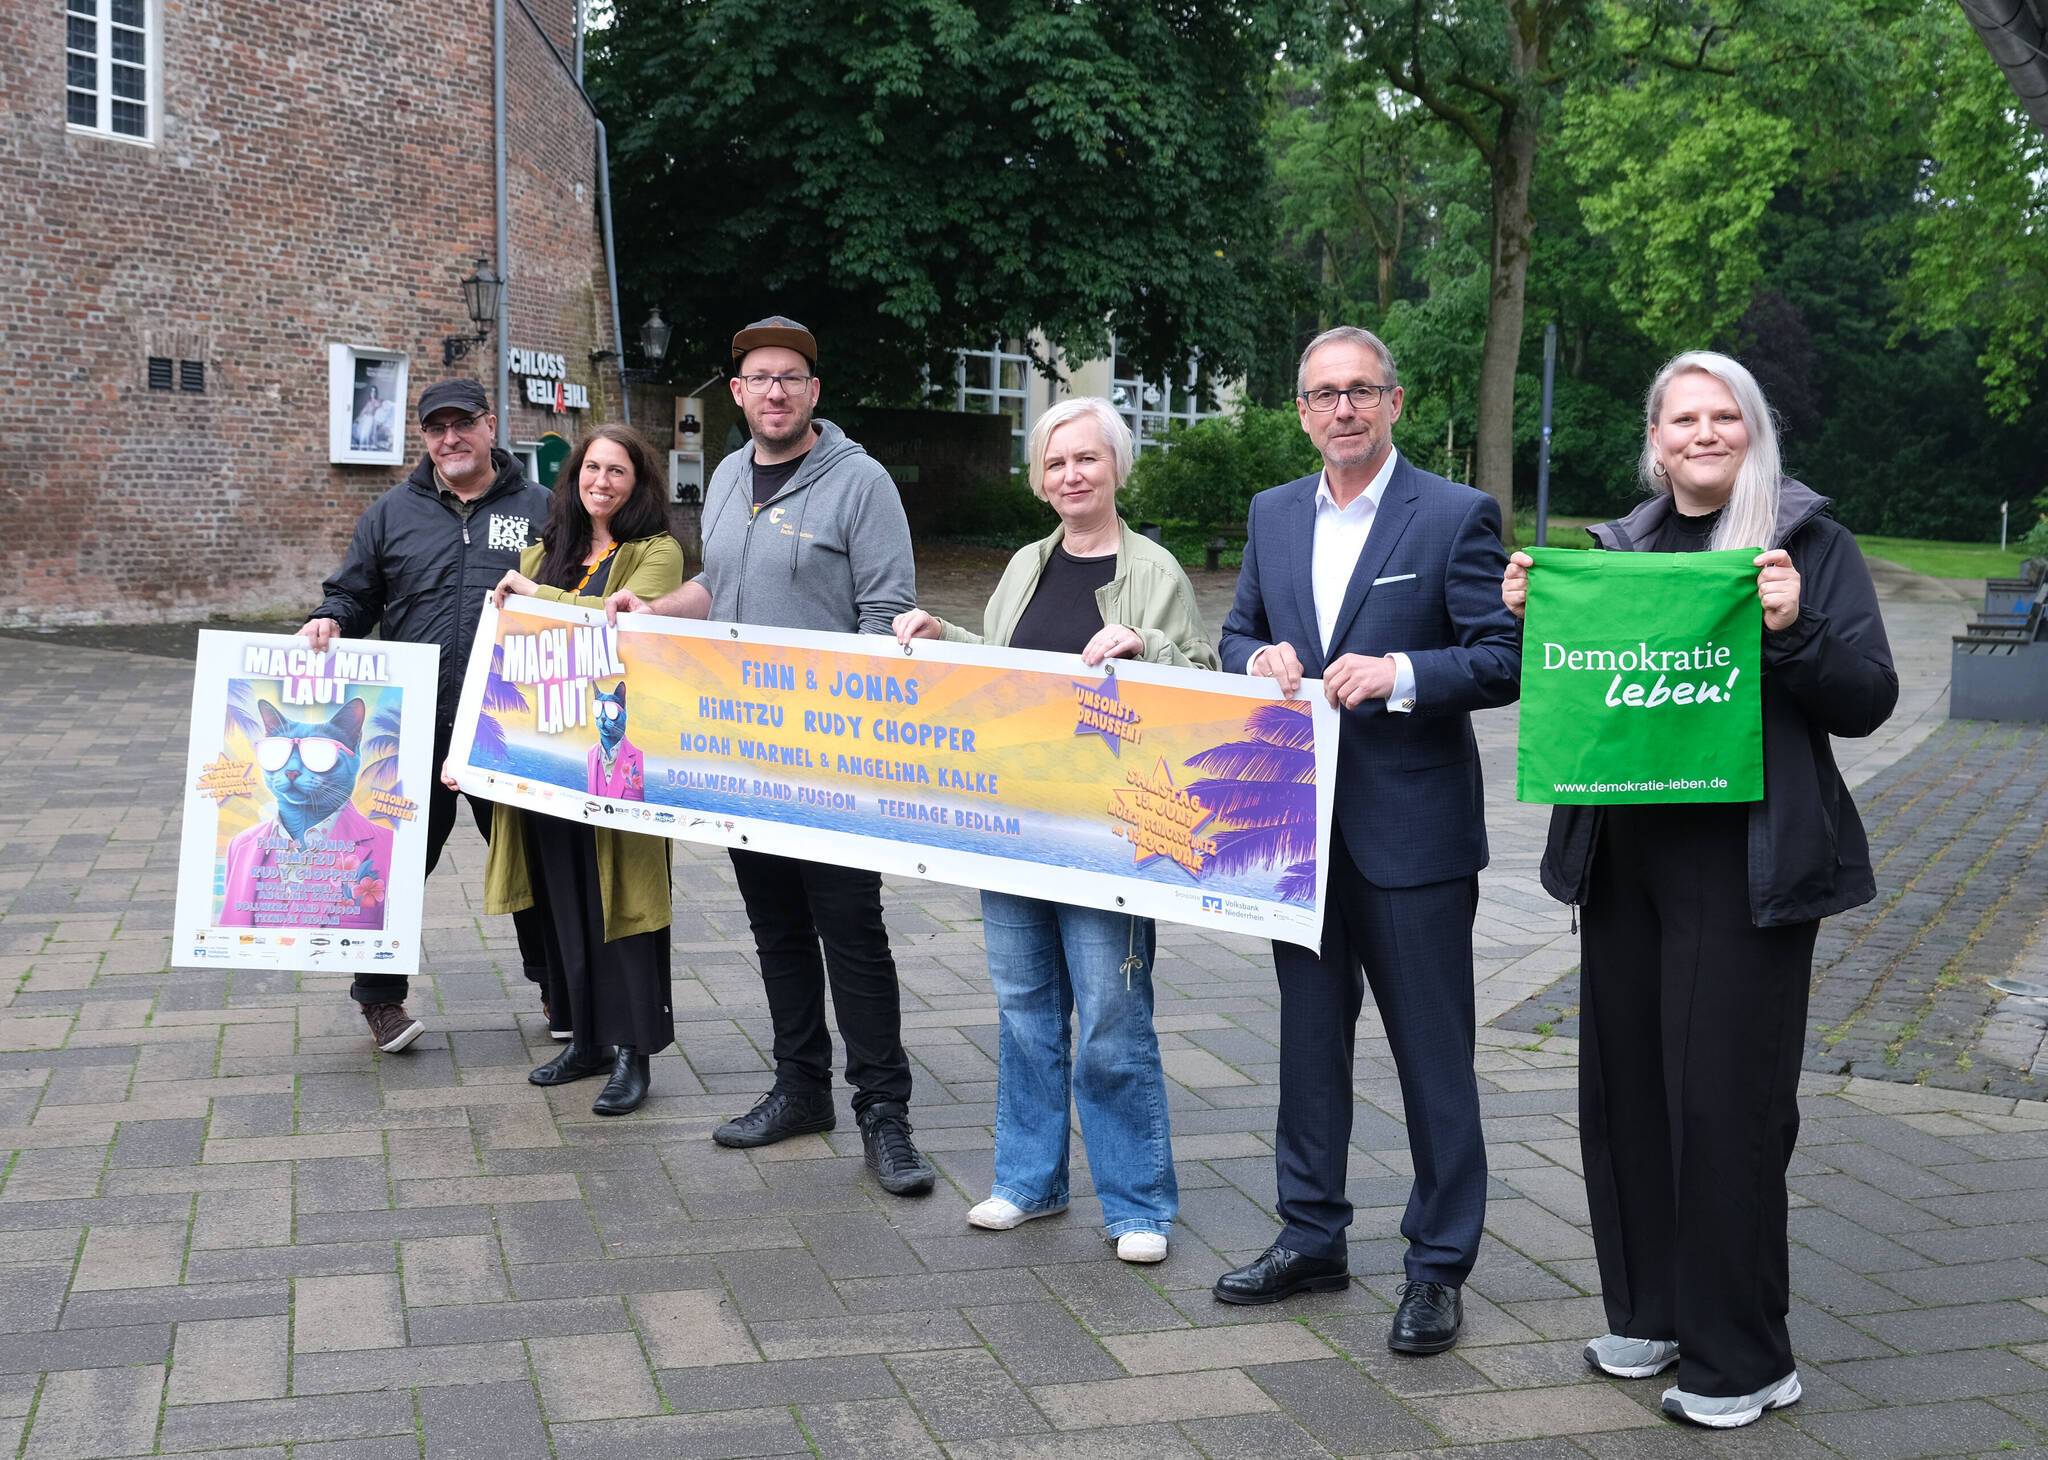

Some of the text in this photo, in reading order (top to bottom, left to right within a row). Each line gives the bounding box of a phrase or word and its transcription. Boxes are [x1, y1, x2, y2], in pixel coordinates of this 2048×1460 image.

[507, 347, 566, 379] CHLOSS
[489, 527, 528, 540] EAT
[490, 517, 529, 531] DOG
[489, 536, 528, 549] DOG
[245, 646, 389, 681] MACH MAL
[502, 624, 626, 684] MACH MAL
[1543, 641, 1731, 672] Demokratie
[282, 676, 350, 705] LAUT
[806, 669, 818, 690] &
[828, 671, 919, 705] JONAS
[1076, 687, 1134, 722] UMSONST
[1605, 667, 1740, 709] leben!
[537, 677, 588, 735] LAUT
[804, 710, 863, 739] RUDY
[872, 719, 976, 753] CHOPPER
[680, 732, 731, 756] NOAH
[738, 739, 813, 768] WARWEL
[820, 752, 830, 768] &
[938, 767, 998, 795] KALKE
[667, 768, 747, 794] BOLLWERK
[753, 779, 792, 801] BAND
[878, 799, 948, 825] TEENAGE
[954, 809, 1021, 835] BEDLAM
[1127, 768, 1200, 813] SAMSTAG
[1553, 777, 1728, 793] www.demokratie-leben.de
[1225, 899, 1259, 912] Volksbank
[1225, 908, 1264, 922] Niederrhein
